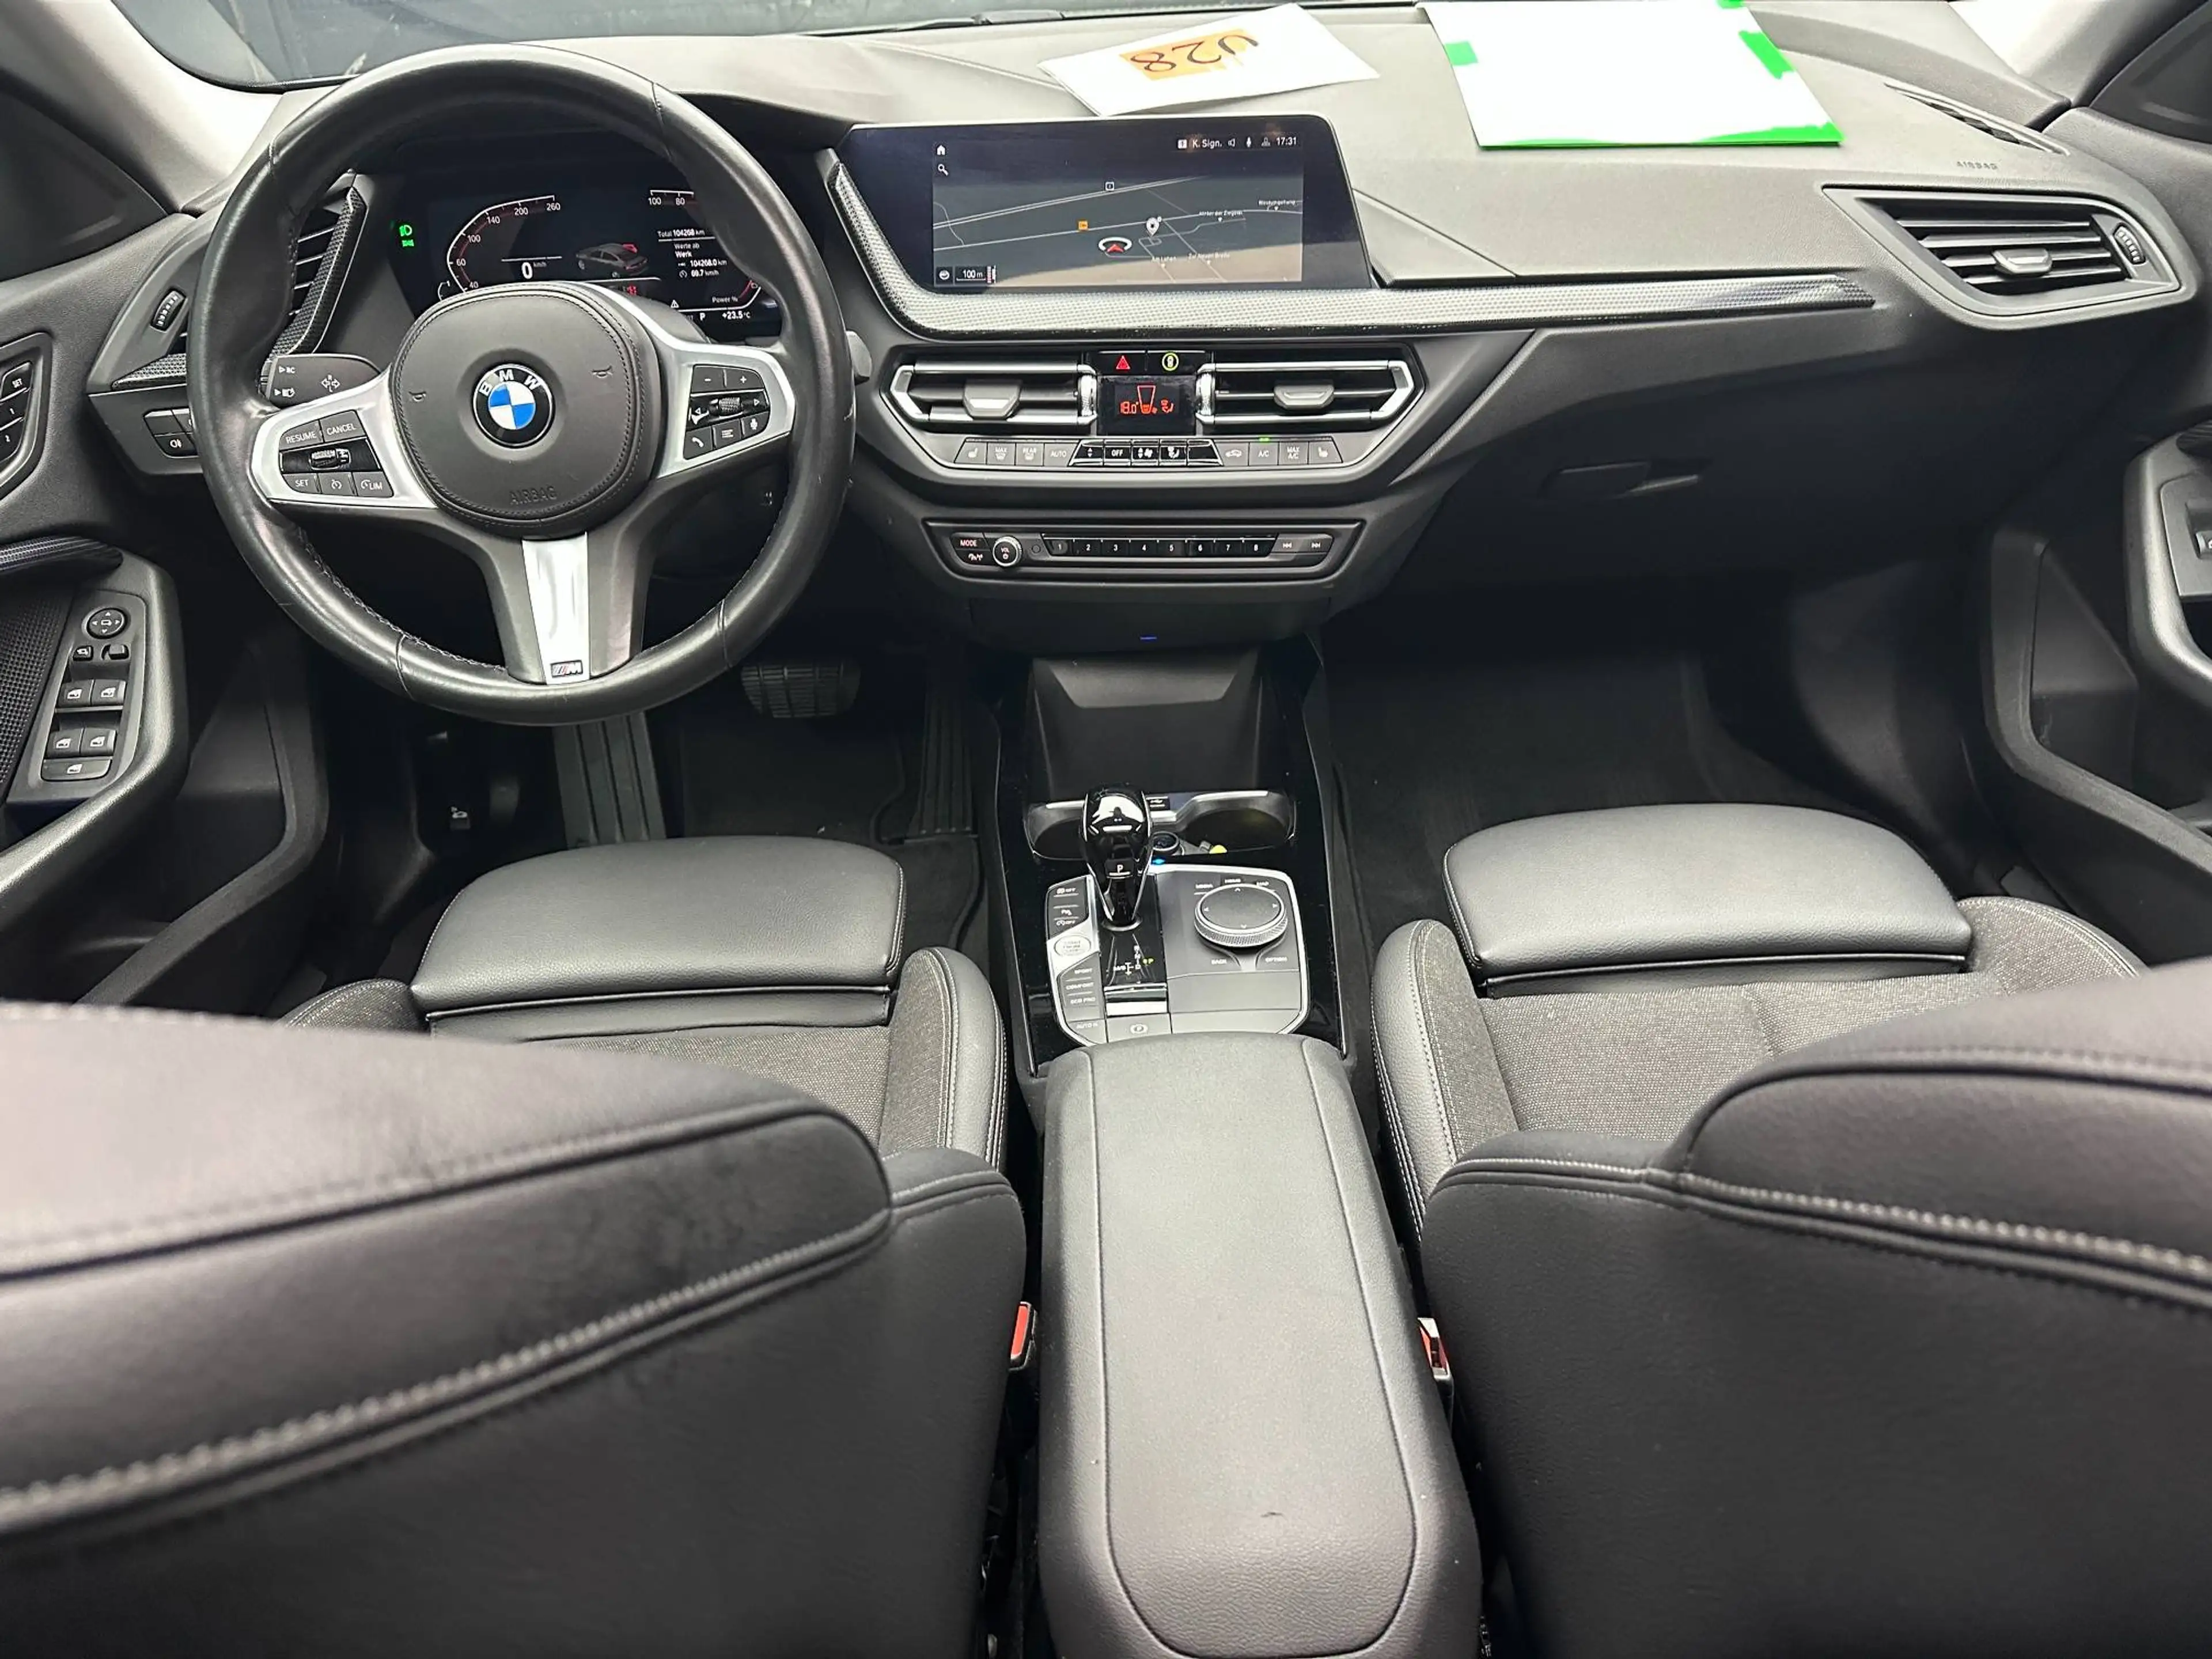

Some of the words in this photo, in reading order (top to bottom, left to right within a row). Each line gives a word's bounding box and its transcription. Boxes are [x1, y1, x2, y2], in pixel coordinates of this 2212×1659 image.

[1276, 137, 1297, 146] 17:31
[514, 207, 529, 215] 200
[546, 203, 561, 211] 260
[487, 216, 500, 224] 140
[468, 234, 482, 243] 100
[521, 262, 533, 279] 0
[963, 270, 976, 278] 100
[12, 378, 22, 388] SET
[479, 369, 540, 397] BMW
[327, 423, 357, 435] CANCEL
[286, 431, 317, 444] RESUME
[295, 479, 309, 487] SET
[370, 482, 382, 490] LIM
[509, 486, 558, 505] AIRBAG
[1117, 865, 1123, 873] P
